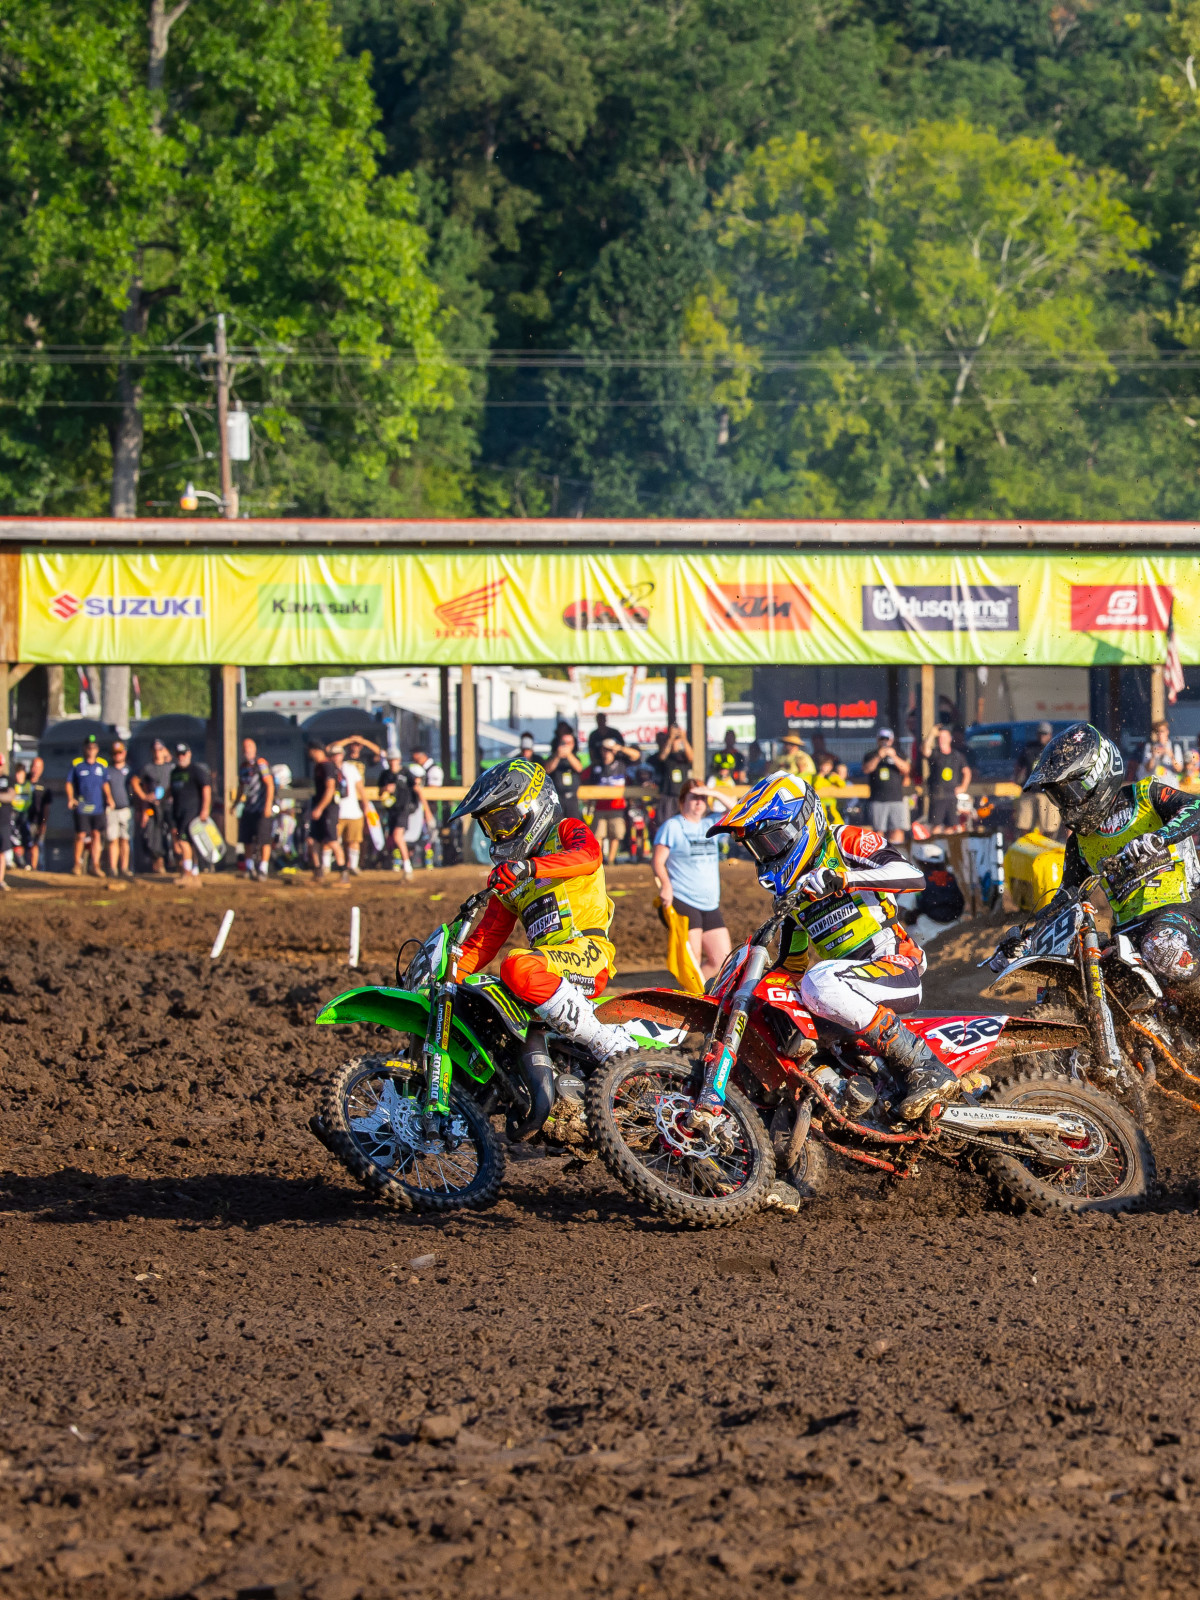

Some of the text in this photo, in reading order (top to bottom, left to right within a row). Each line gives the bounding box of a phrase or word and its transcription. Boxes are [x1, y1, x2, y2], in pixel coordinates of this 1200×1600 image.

[85, 597, 204, 616] SUZUKI
[272, 598, 369, 615] Kawasaki
[725, 596, 792, 618] KTM
[899, 596, 1008, 621] Husqvarna
[435, 628, 511, 639] HONDA
[808, 904, 854, 936] HAMPIONSHIP
[1036, 908, 1075, 954] 59
[938, 1018, 1003, 1046] 58
[431, 1053, 442, 1100] DUNLOP
[718, 1057, 731, 1083] MOTOREX
